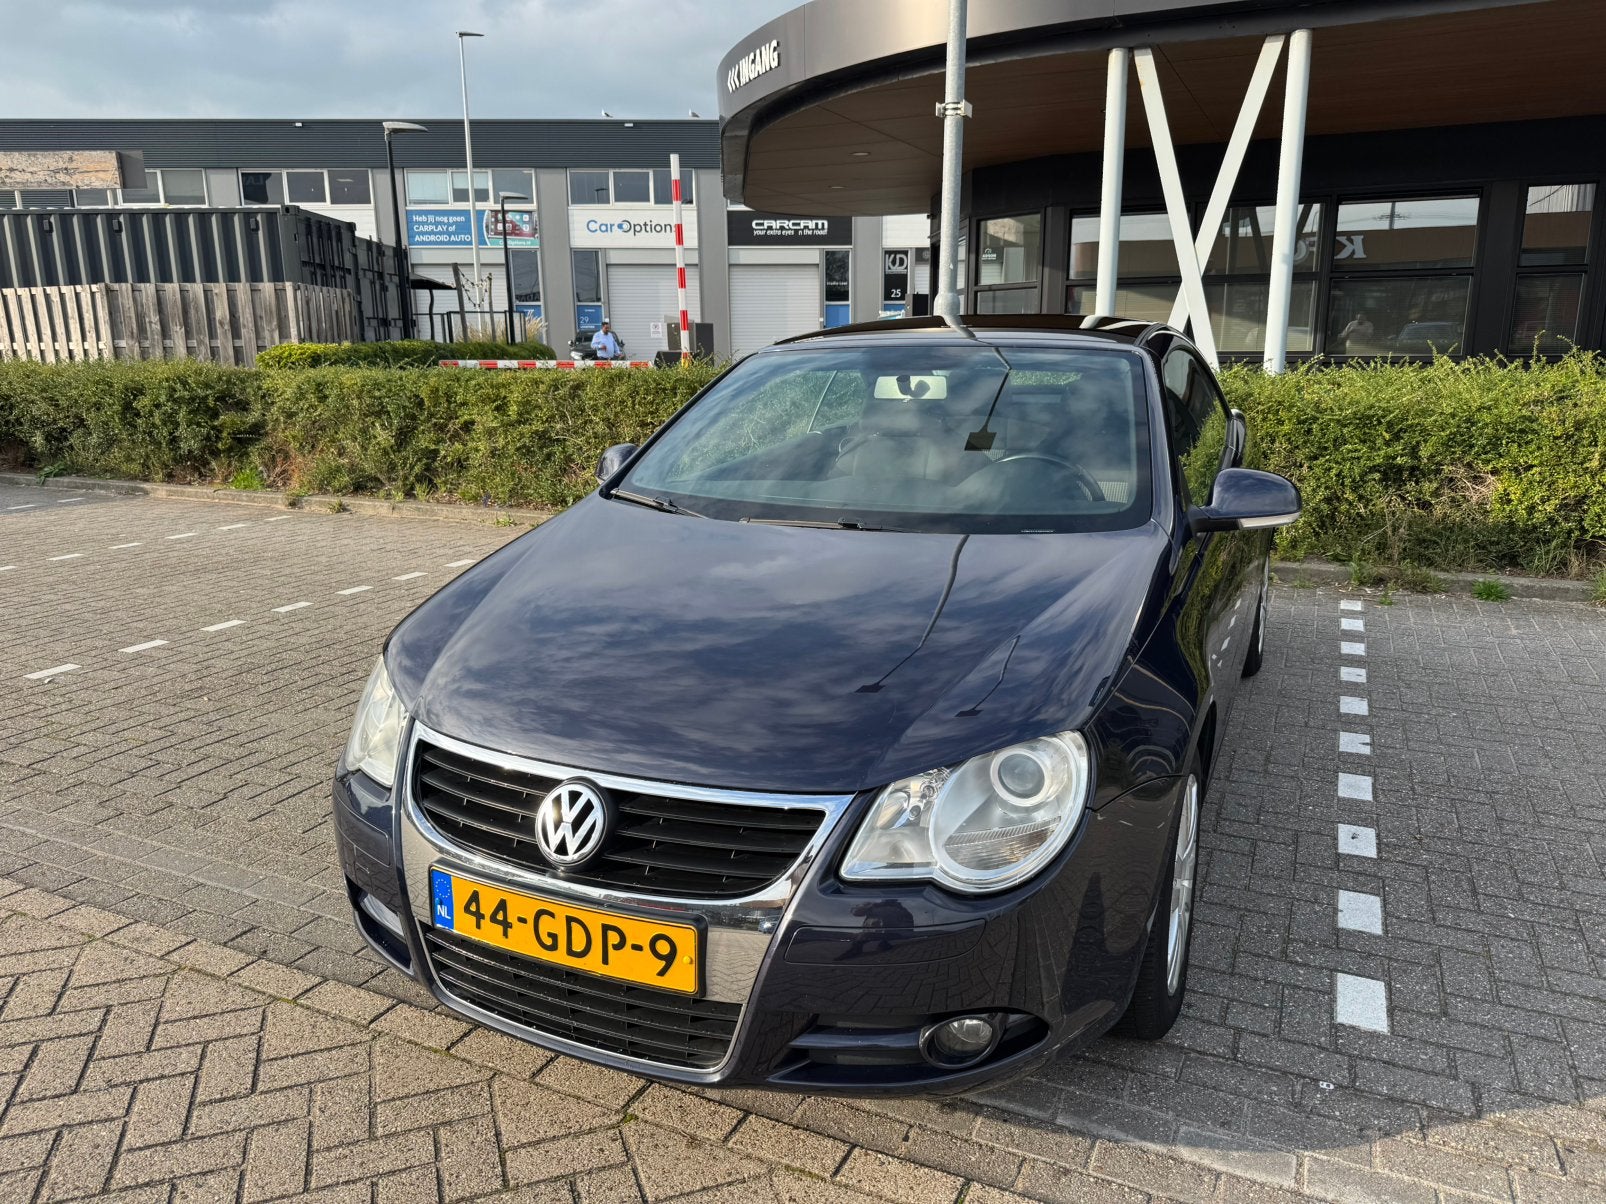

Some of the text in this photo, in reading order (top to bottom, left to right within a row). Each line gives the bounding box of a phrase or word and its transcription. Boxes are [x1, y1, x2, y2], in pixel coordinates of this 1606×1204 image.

[739, 39, 779, 87] INGANG
[752, 219, 828, 229] CARCAM
[767, 228, 781, 236] extra
[415, 234, 471, 242] ANDROID AUTO
[891, 289, 901, 298] 25
[437, 904, 452, 920] NL
[463, 889, 678, 977] 44-GDP-9
